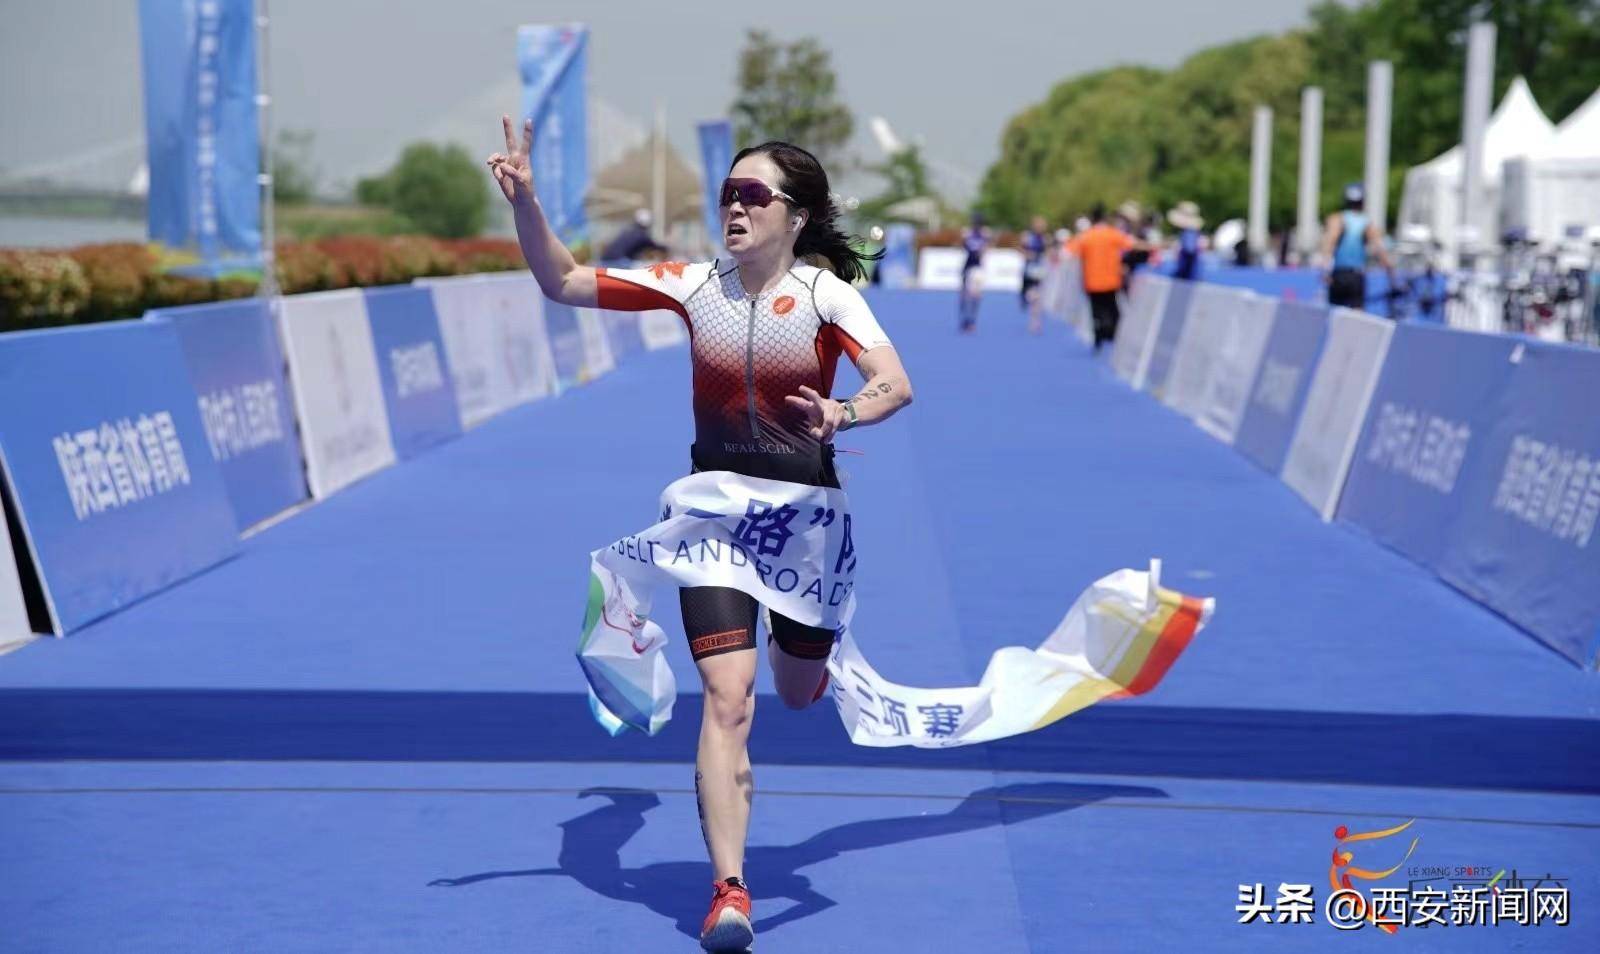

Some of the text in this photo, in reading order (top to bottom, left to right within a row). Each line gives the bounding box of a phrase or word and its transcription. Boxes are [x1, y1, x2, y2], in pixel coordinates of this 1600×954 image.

[52, 410, 191, 520] 陕西省体育局
[672, 538, 748, 567] AND
